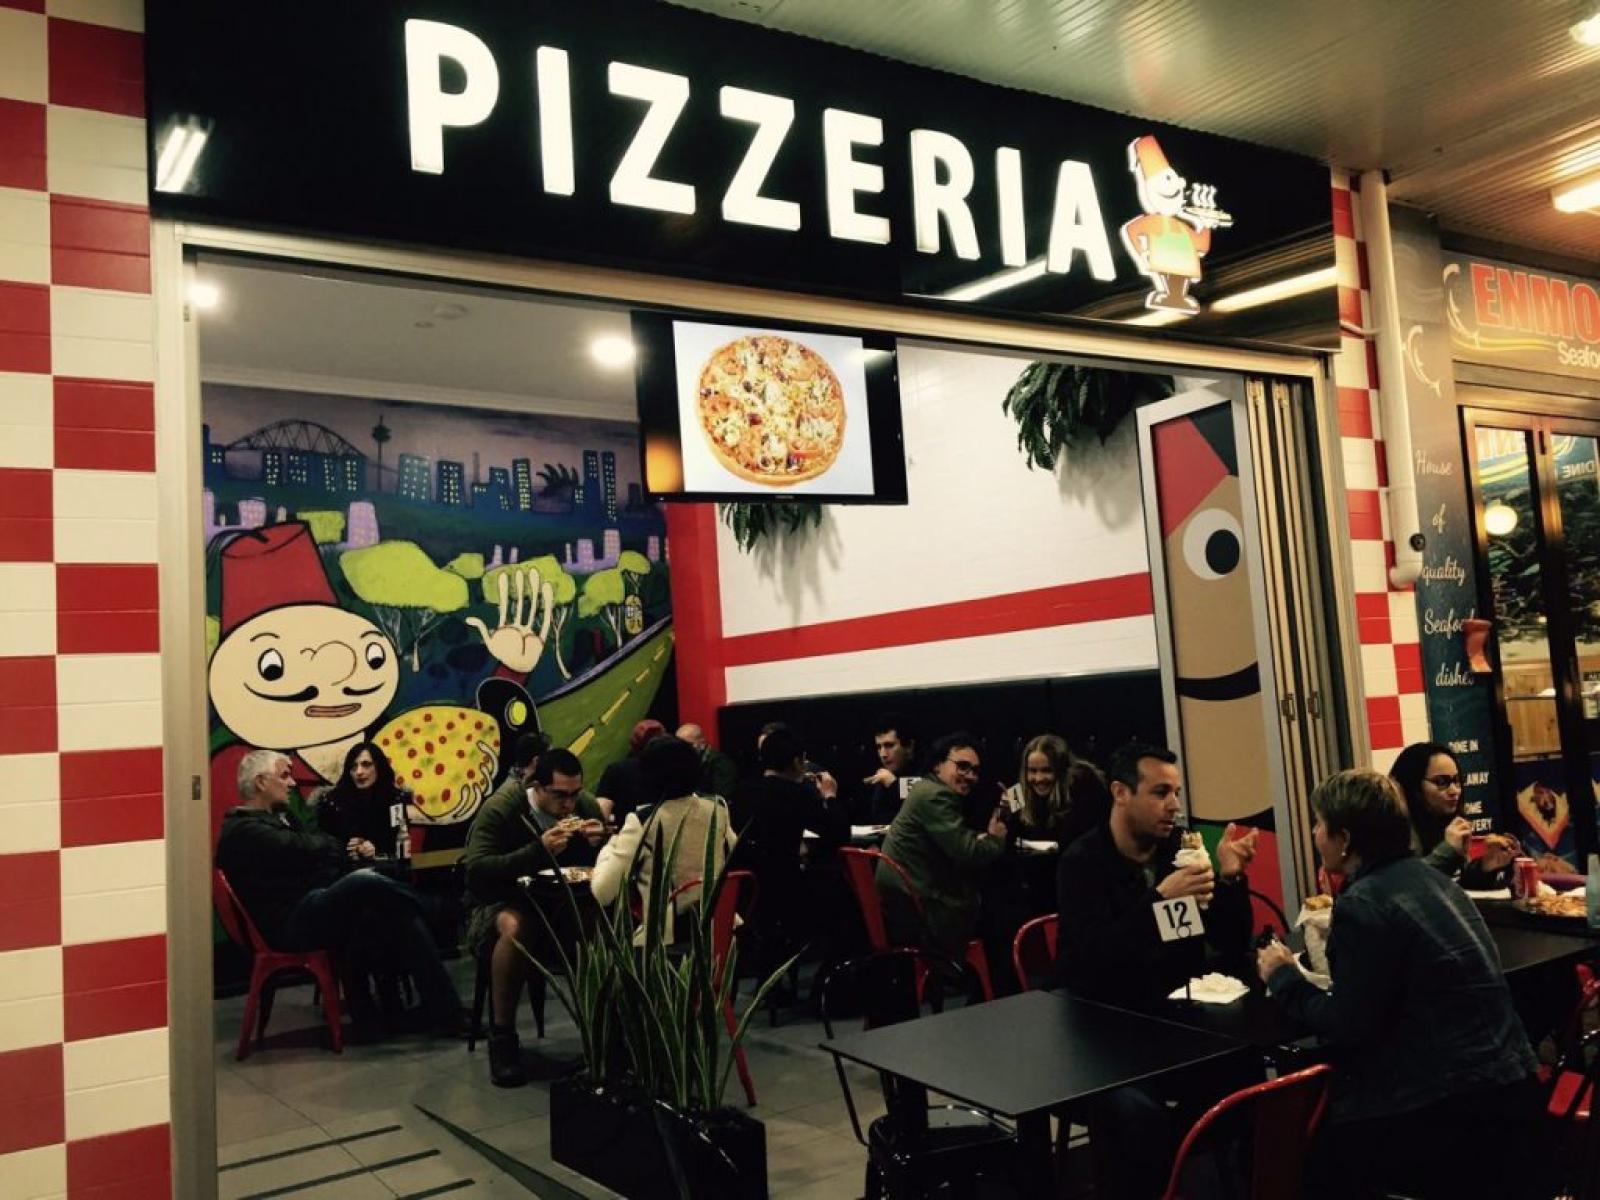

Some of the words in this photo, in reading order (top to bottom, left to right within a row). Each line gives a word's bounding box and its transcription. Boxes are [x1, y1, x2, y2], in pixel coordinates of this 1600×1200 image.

[404, 18, 1116, 282] PIZZERIA
[1470, 263, 1600, 344] ENMO
[1413, 449, 1453, 476] House
[1432, 503, 1446, 533] of
[1421, 555, 1465, 587] quality
[1162, 901, 1192, 929] 12
